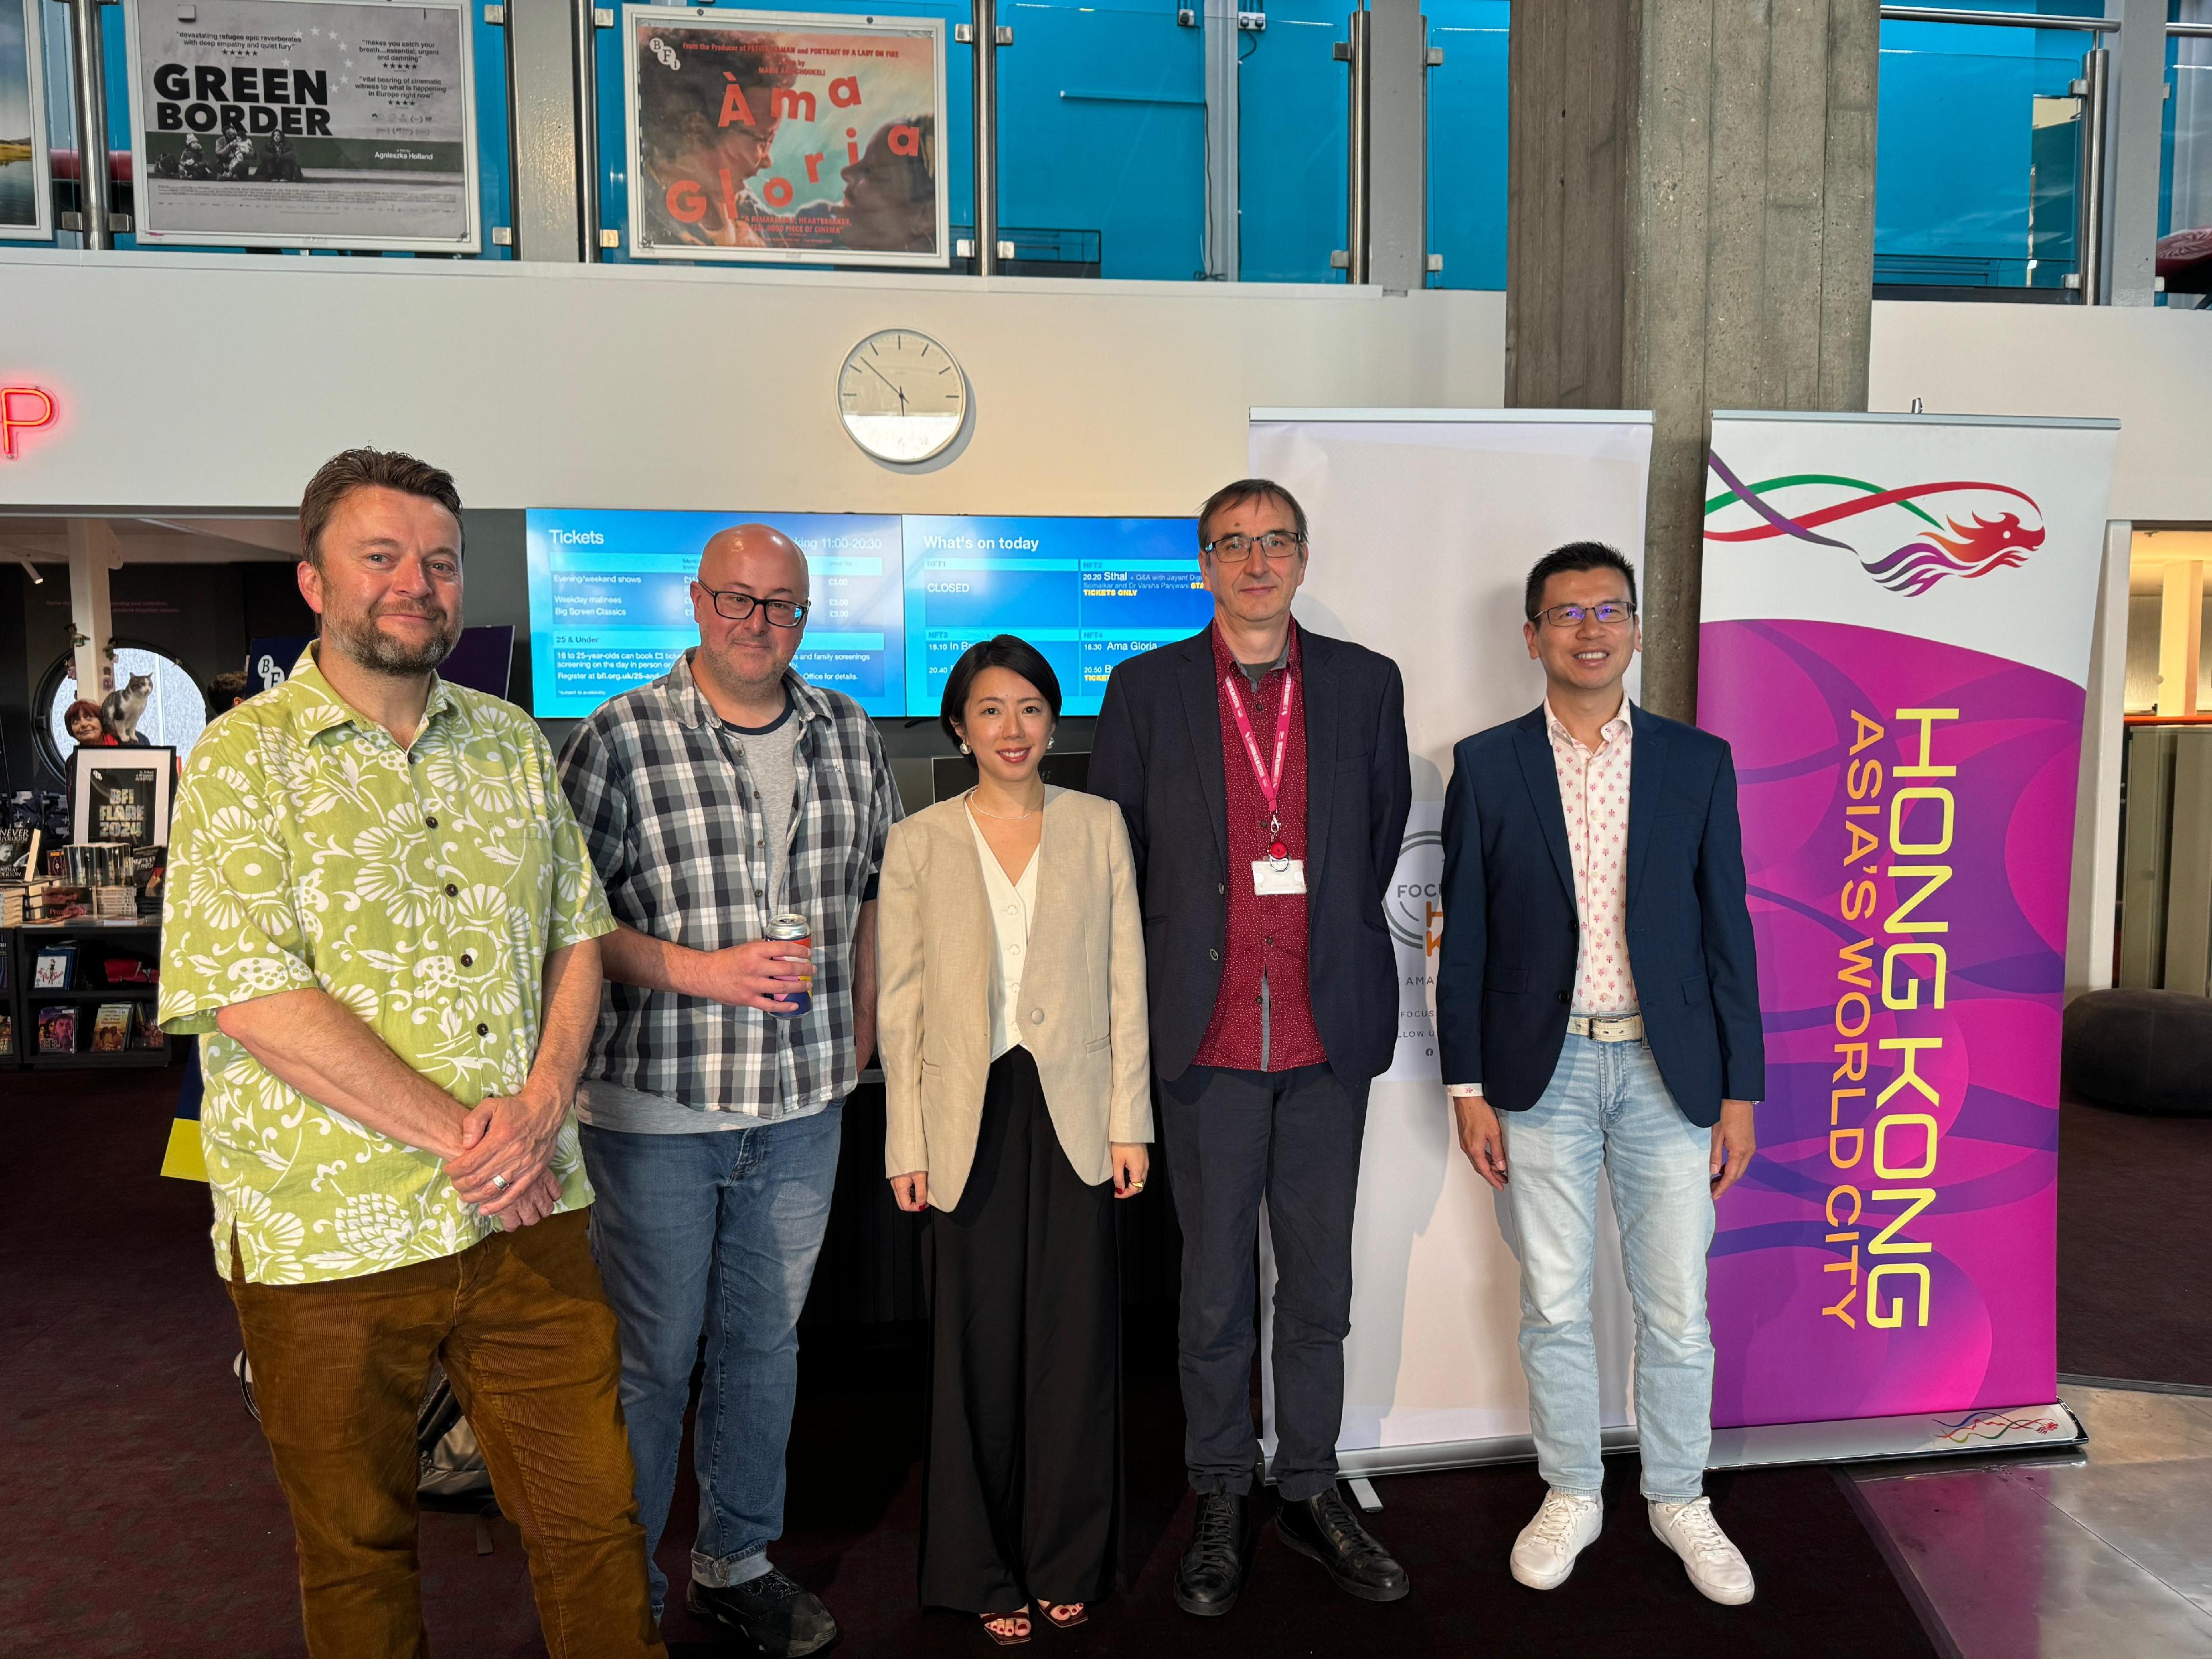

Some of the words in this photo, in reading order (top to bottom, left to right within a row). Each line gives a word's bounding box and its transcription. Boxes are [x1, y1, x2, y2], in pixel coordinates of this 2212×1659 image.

[653, 39, 679, 69] BFI
[153, 63, 328, 106] GREEN
[156, 101, 332, 136] BORDER
[374, 152, 408, 160] Agnieszka
[409, 152, 434, 160] Holland
[548, 529, 604, 545] Tickets
[822, 538, 881, 549] 11:00-20:30
[924, 535, 973, 549] What's
[977, 539, 995, 549] on
[999, 536, 1039, 552] today
[554, 575, 616, 584] Evening/weekend
[828, 578, 848, 586] £3.00
[1104, 571, 1128, 581] Sthal
[1167, 574, 1188, 582] Jayant
[927, 582, 969, 593] CLOSED
[555, 596, 588, 605] Weekday
[555, 608, 567, 617] Big
[569, 608, 594, 616] Screen
[596, 608, 626, 616] Classics
[950, 641, 959, 650] In
[1107, 641, 1128, 650] Ama
[1130, 641, 1157, 651] Gloria
[576, 652, 619, 661] 25-year-olds
[814, 653, 833, 661] family
[834, 653, 870, 661] screenings
[557, 661, 591, 670] screening
[615, 660, 629, 669] day
[557, 672, 586, 681] Register
[109, 789, 134, 805] BFI
[99, 805, 144, 821] FLARE
[1840, 709, 1884, 920] ASIA'S
[0, 828, 29, 837] NEVER
[100, 821, 142, 837] 2024
[1882, 708, 1960, 1010] HONG
[1397, 884, 1441, 898] FOC
[1829, 937, 1874, 1168] WORLD
[1866, 1037, 1943, 1328] KONG
[1822, 1185, 1861, 1329] CITY
